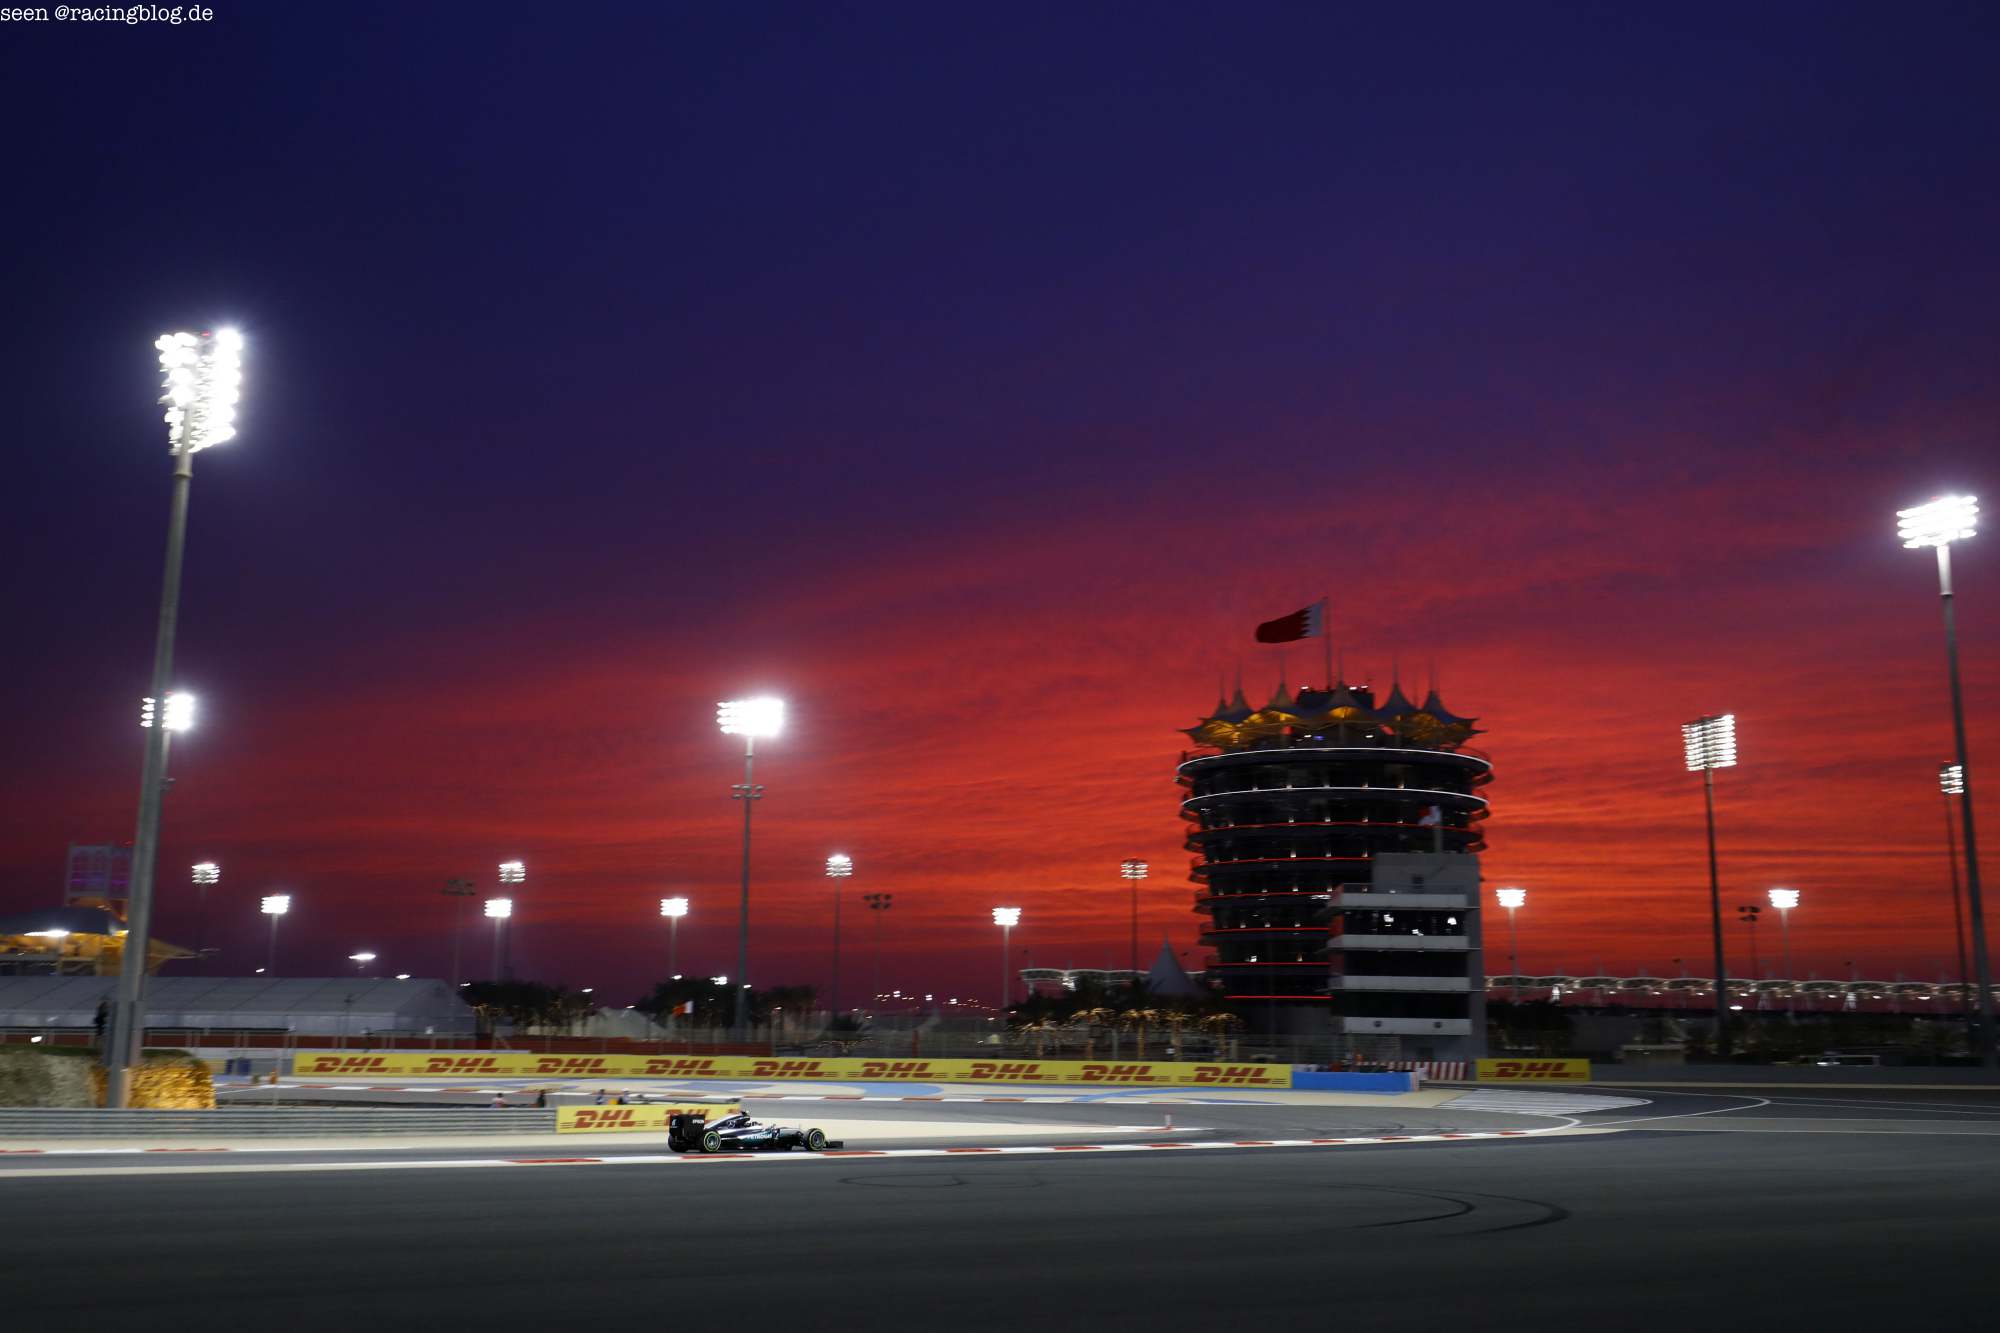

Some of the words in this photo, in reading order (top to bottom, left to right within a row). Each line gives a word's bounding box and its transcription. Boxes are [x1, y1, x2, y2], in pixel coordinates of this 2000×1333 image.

[314, 1057, 388, 1073] DHL
[425, 1058, 499, 1074] DHL
[537, 1058, 609, 1075] DHL
[645, 1060, 719, 1076] DHL
[752, 1061, 825, 1077] DHL
[862, 1062, 936, 1078] DHL
[970, 1064, 1044, 1080] DHL
[1082, 1065, 1156, 1082] DHL
[1194, 1067, 1271, 1083] DHL
[1496, 1062, 1570, 1078] DHL
[575, 1109, 635, 1128] DHL
